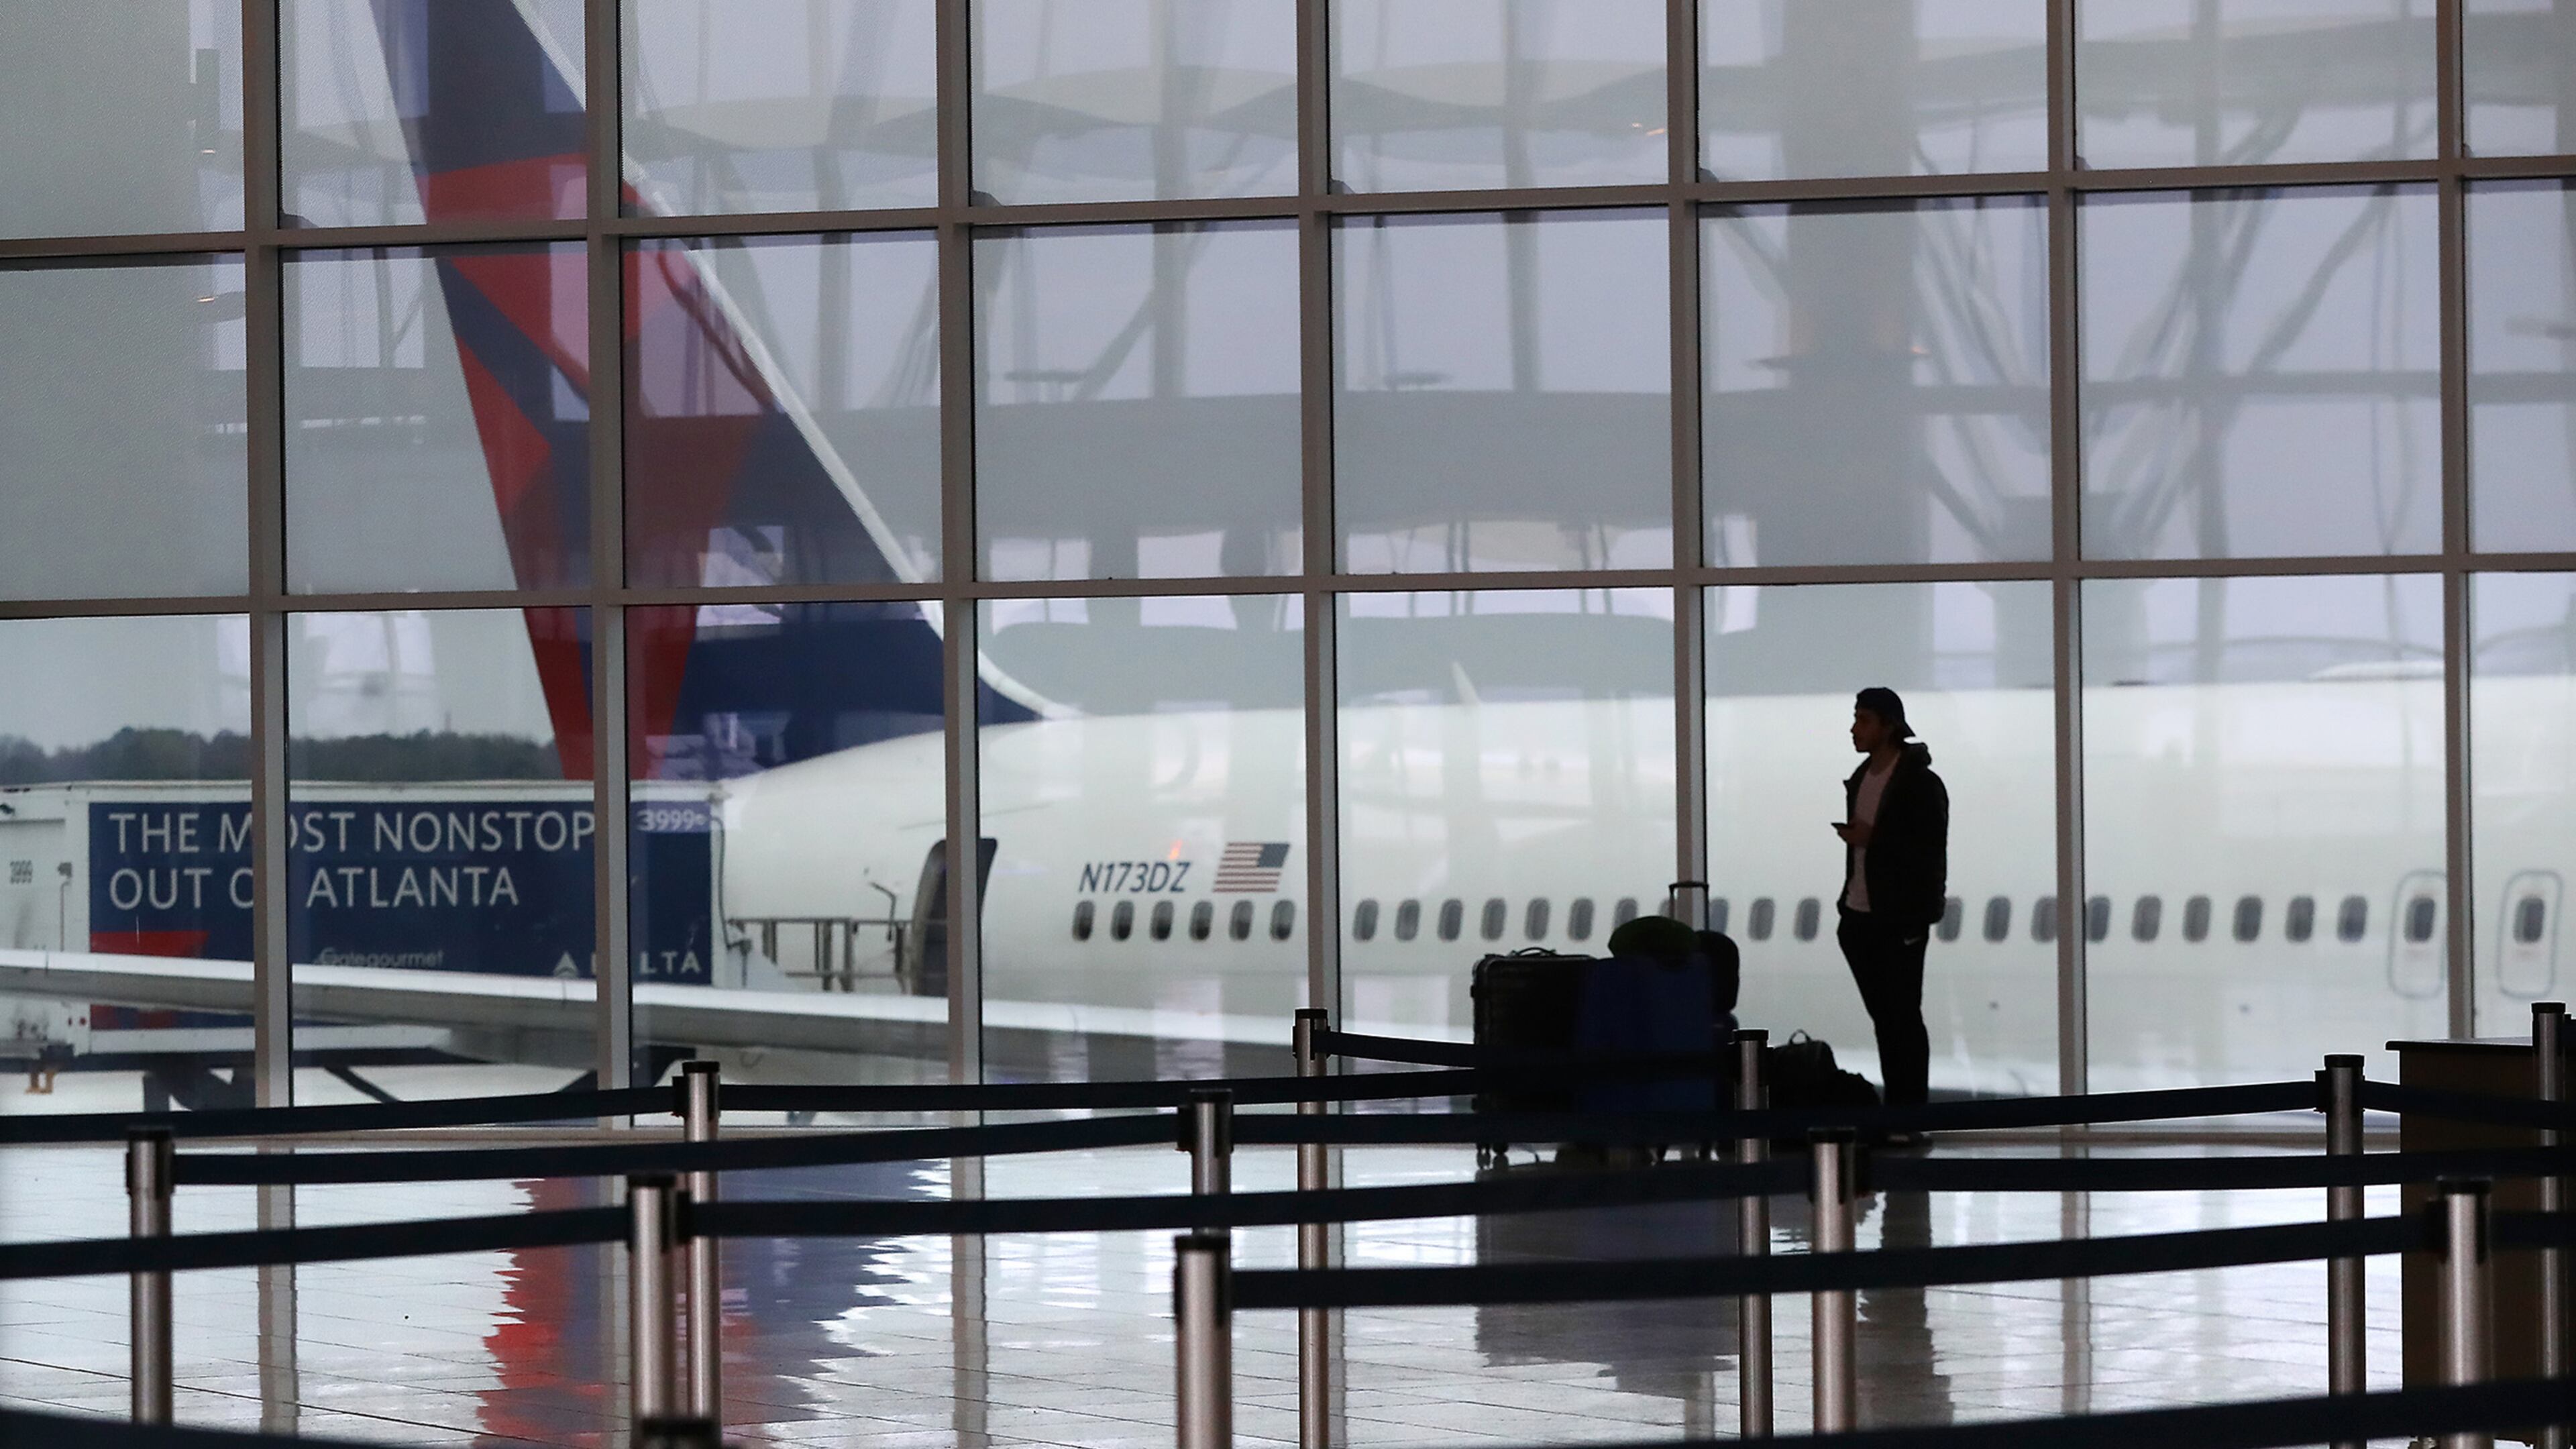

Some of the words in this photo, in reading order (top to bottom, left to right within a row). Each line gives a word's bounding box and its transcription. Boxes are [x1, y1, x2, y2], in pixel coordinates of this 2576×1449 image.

[108, 812, 200, 853] THE
[218, 812, 356, 853] MST
[374, 810, 595, 853] NONSTOP
[109, 867, 212, 910] OUT
[229, 867, 254, 909] O
[305, 866, 519, 908] ATLANTA
[1078, 861, 1192, 894] N173DZ
[591, 951, 702, 975] LTA
